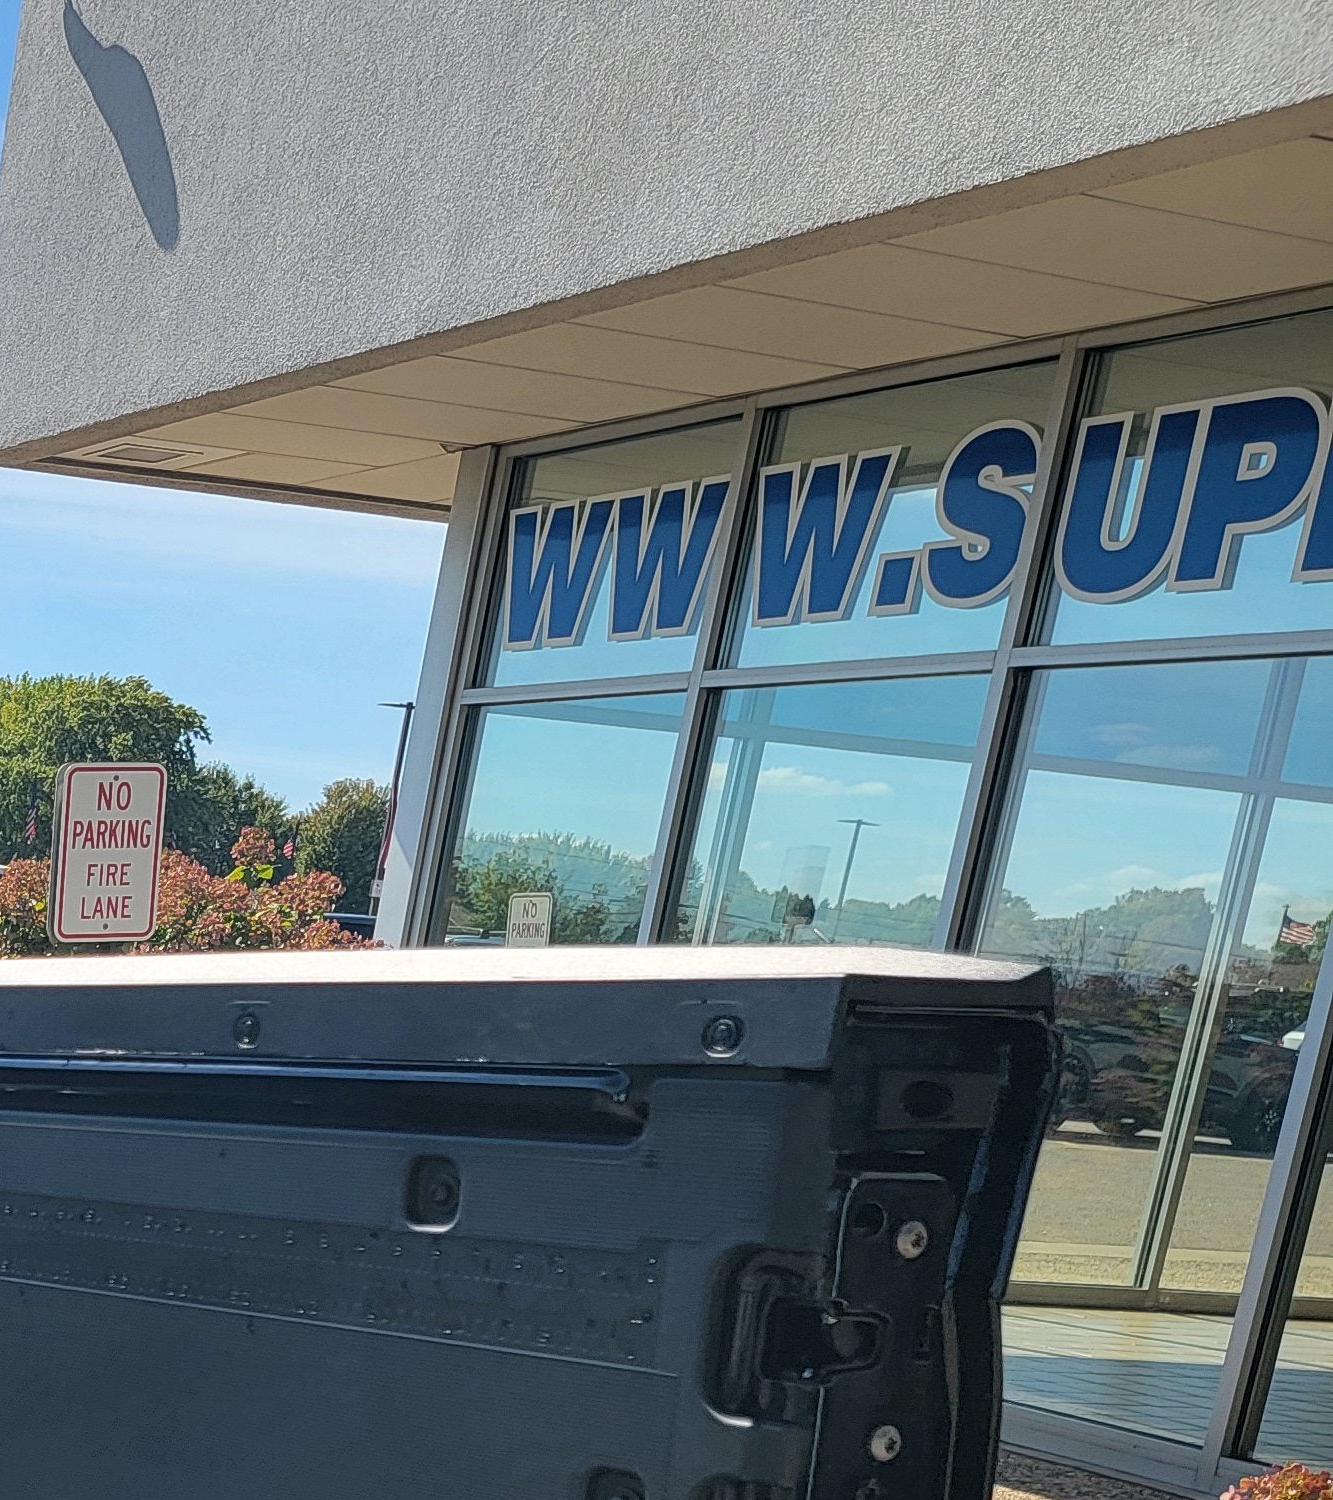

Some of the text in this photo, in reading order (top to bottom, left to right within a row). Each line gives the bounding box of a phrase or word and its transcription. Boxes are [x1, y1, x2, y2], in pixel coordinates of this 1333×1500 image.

[503, 386, 1333, 650] WWW.SUP
[97, 781, 132, 812] NO
[71, 819, 152, 850] PARKING
[86, 863, 132, 887] FIRE
[80, 895, 133, 920] LANE
[522, 902, 538, 919] NO
[511, 922, 546, 939] PARKING
